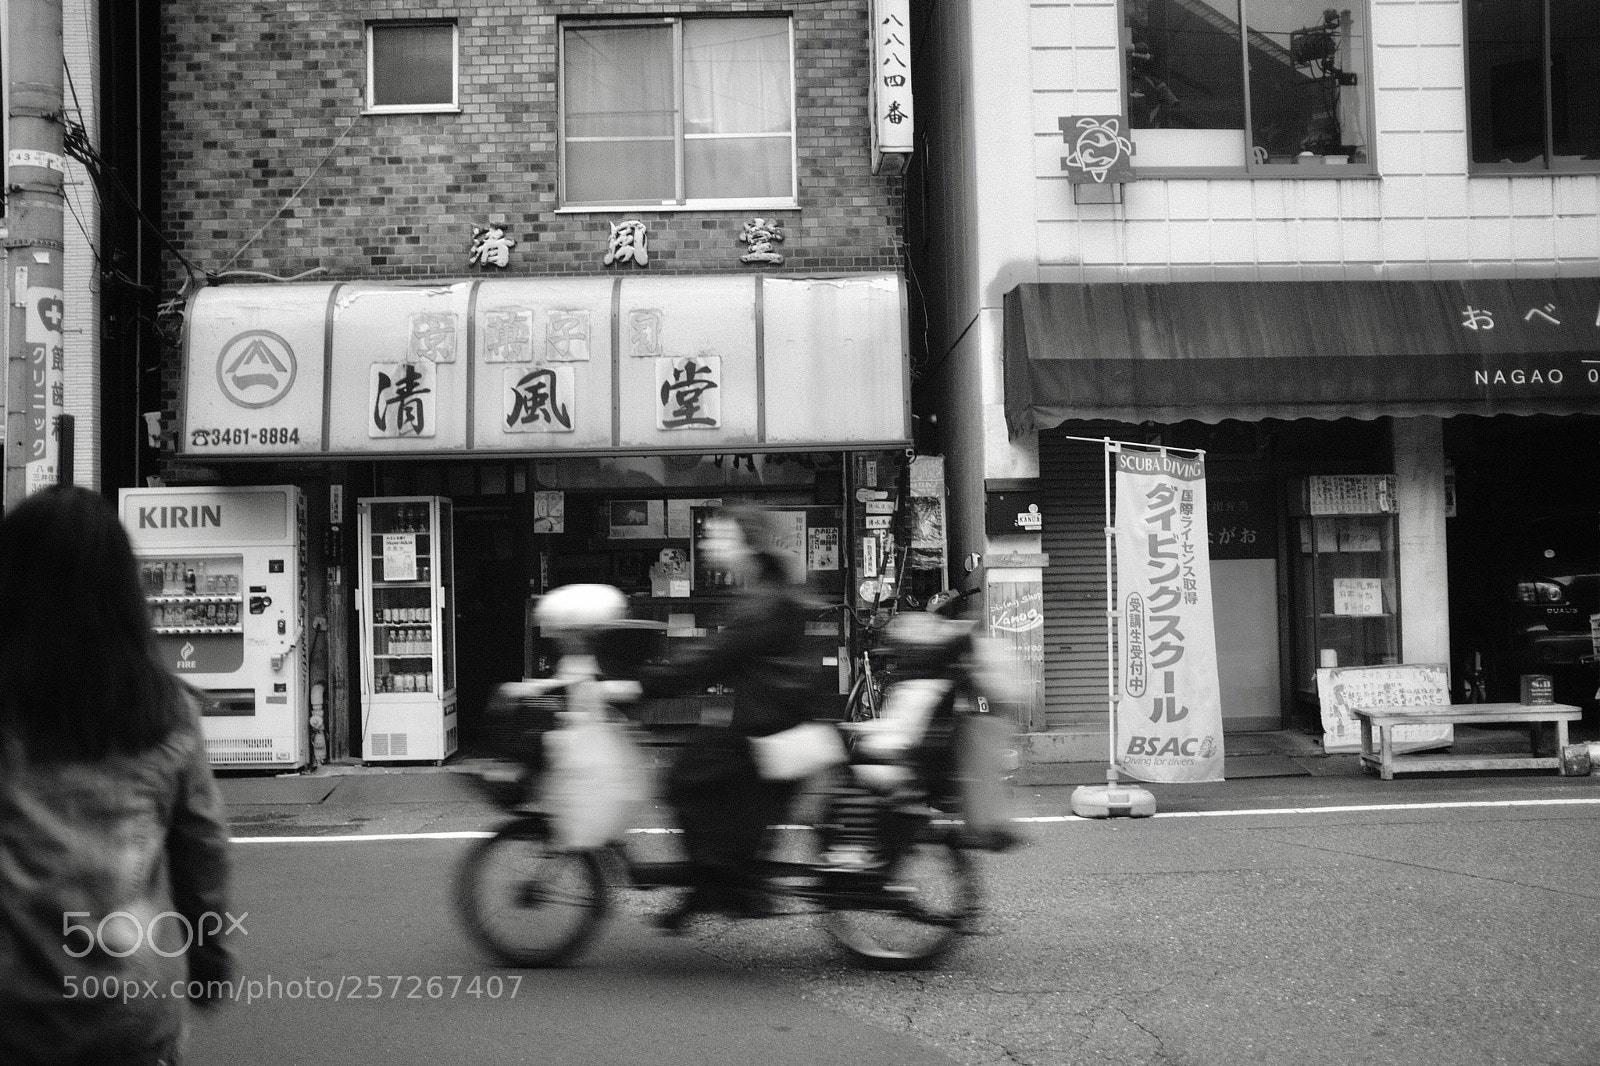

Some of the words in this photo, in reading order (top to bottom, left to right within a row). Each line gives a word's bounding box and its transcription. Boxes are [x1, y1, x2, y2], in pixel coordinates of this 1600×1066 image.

[882, 14, 908, 124] 八八八四番
[1462, 303, 1600, 331] おべ
[1475, 369, 1563, 385] NAGAO
[33, 347, 46, 456] クリニック
[374, 360, 718, 435] 清風堂
[211, 427, 300, 446] 3461-8884
[1120, 455, 1160, 471] SCUBA
[1163, 458, 1201, 477] DIVING
[139, 505, 221, 529] KIRIN
[1179, 489, 1199, 605] 国際ライセンス取得
[1145, 482, 1189, 724] ダイビングスクール
[176, 660, 197, 669] FIRE
[1126, 736, 1199, 757] BSAC
[1123, 756, 1151, 766] Diving
[1153, 757, 1165, 766] for
[1167, 758, 1195, 766] divers
